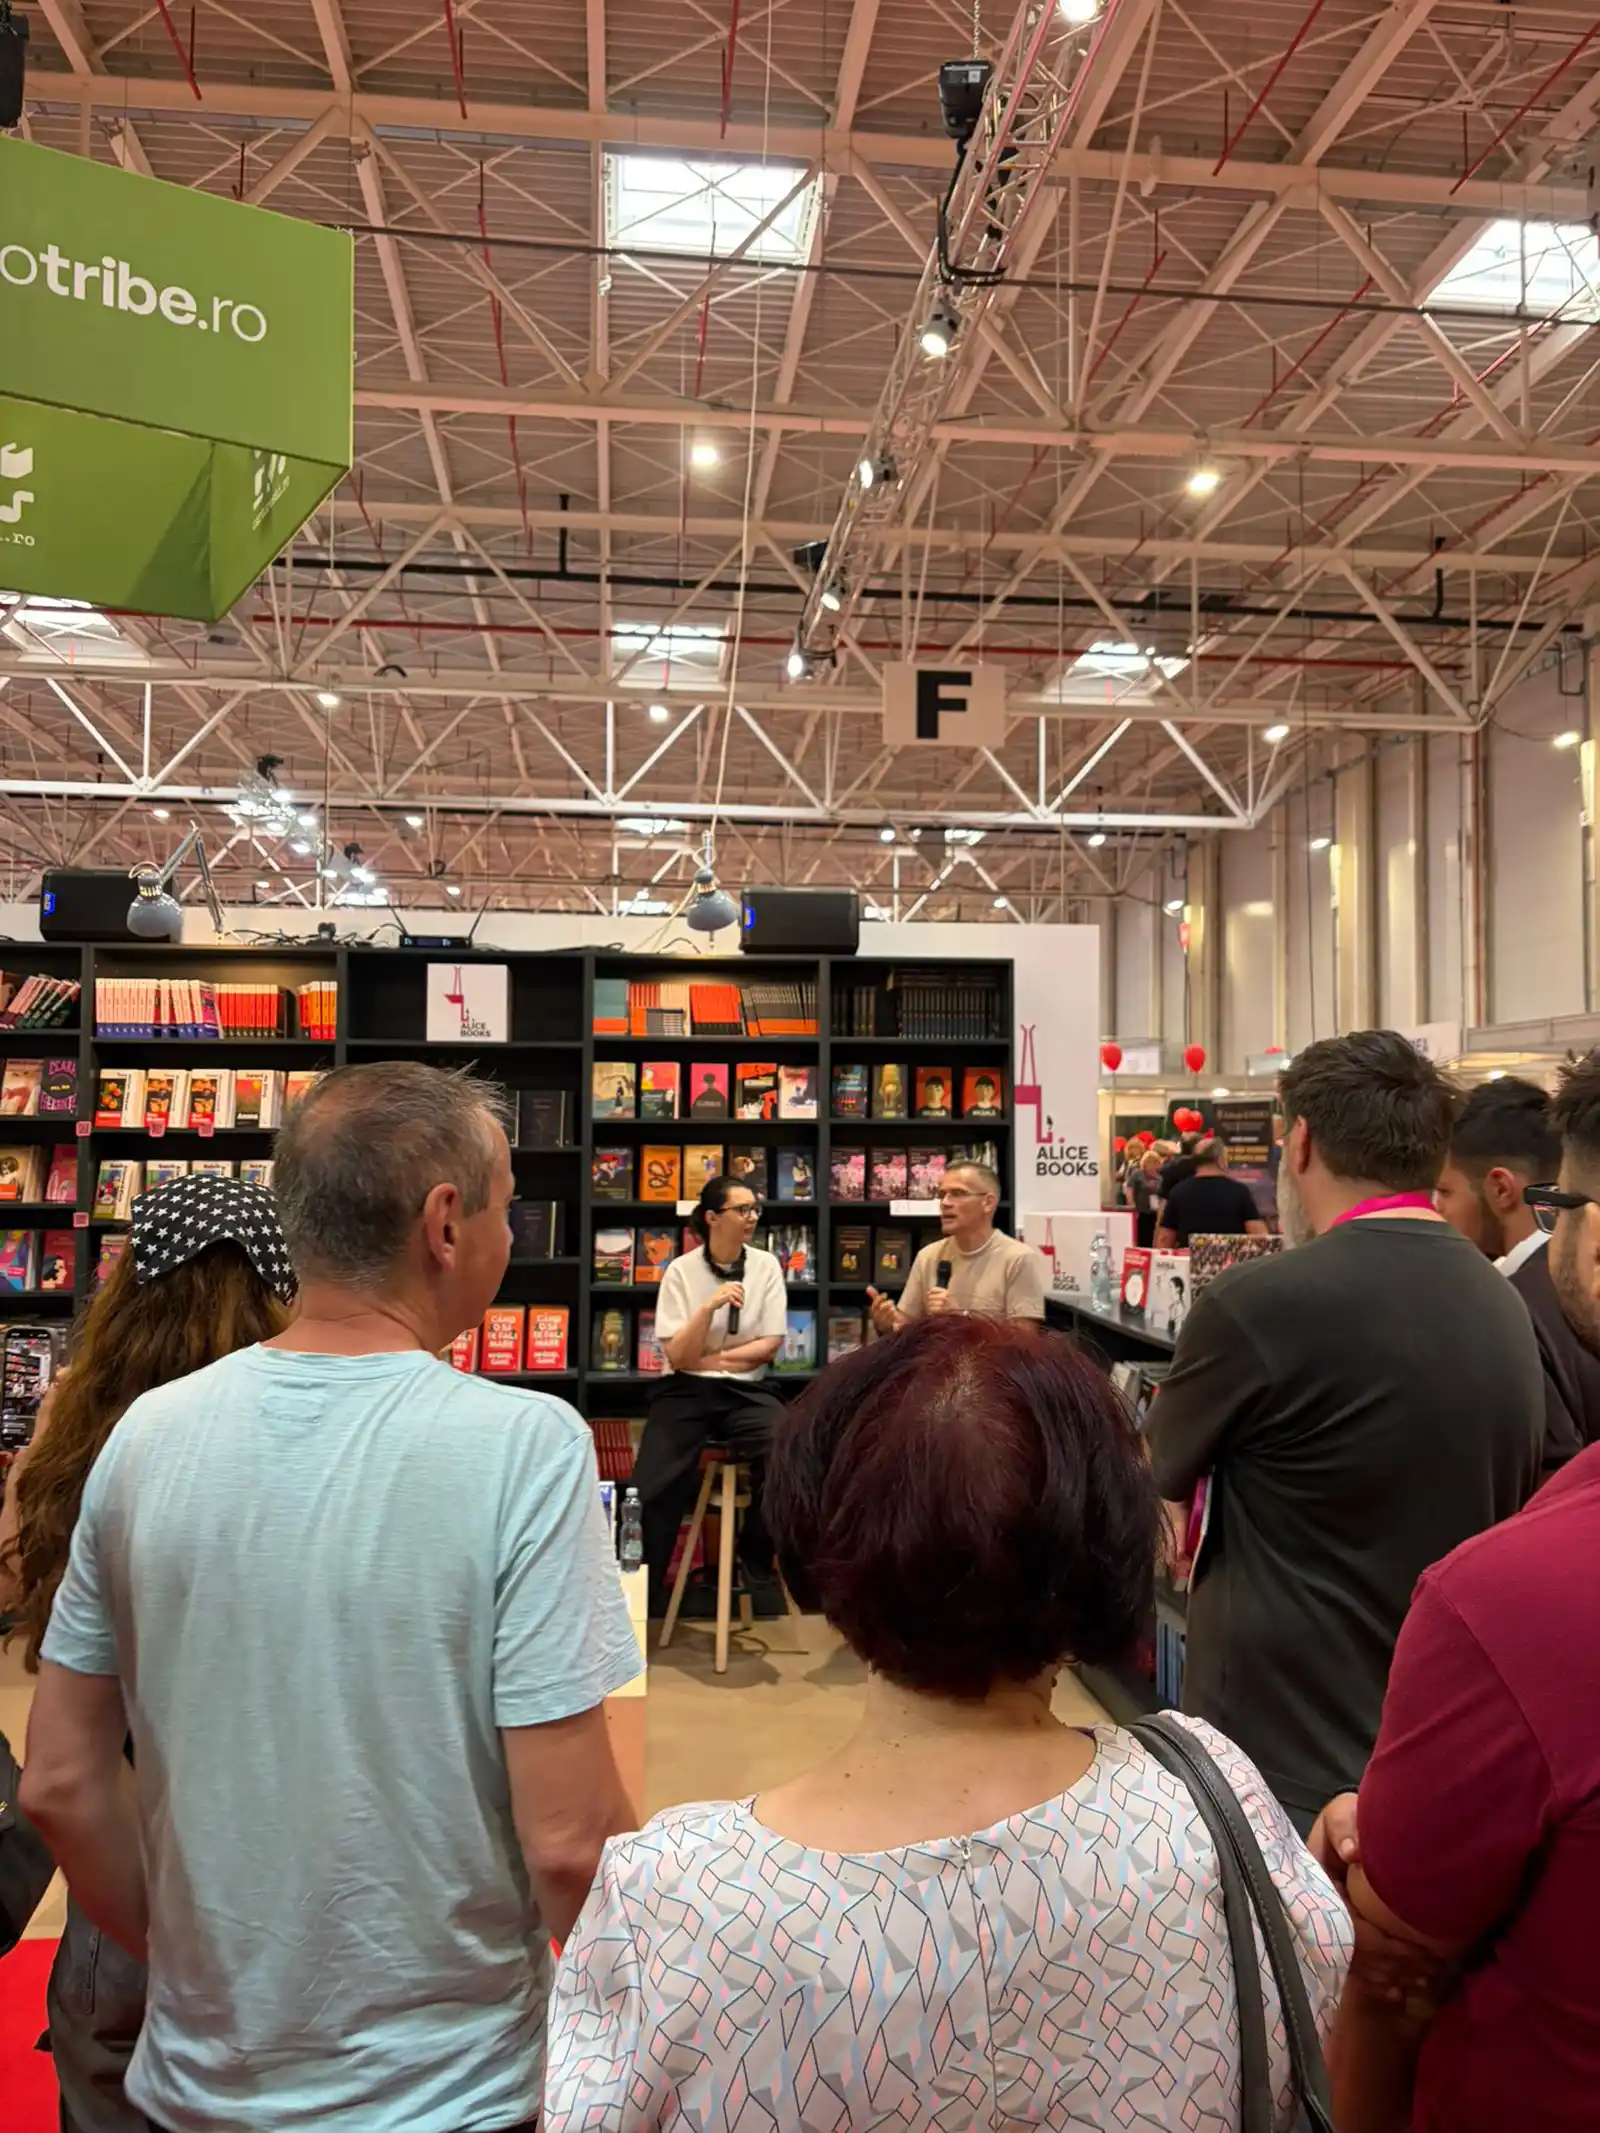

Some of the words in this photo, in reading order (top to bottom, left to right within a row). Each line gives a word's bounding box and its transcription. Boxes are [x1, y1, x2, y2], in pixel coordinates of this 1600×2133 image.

[0, 244, 267, 342] otribe.ro
[917, 670, 972, 739] F
[460, 1029, 491, 1037] BOOKS
[461, 1021, 486, 1030] ALICE
[1036, 1145, 1089, 1160] ALICE
[1036, 1161, 1099, 1176] BOOKS
